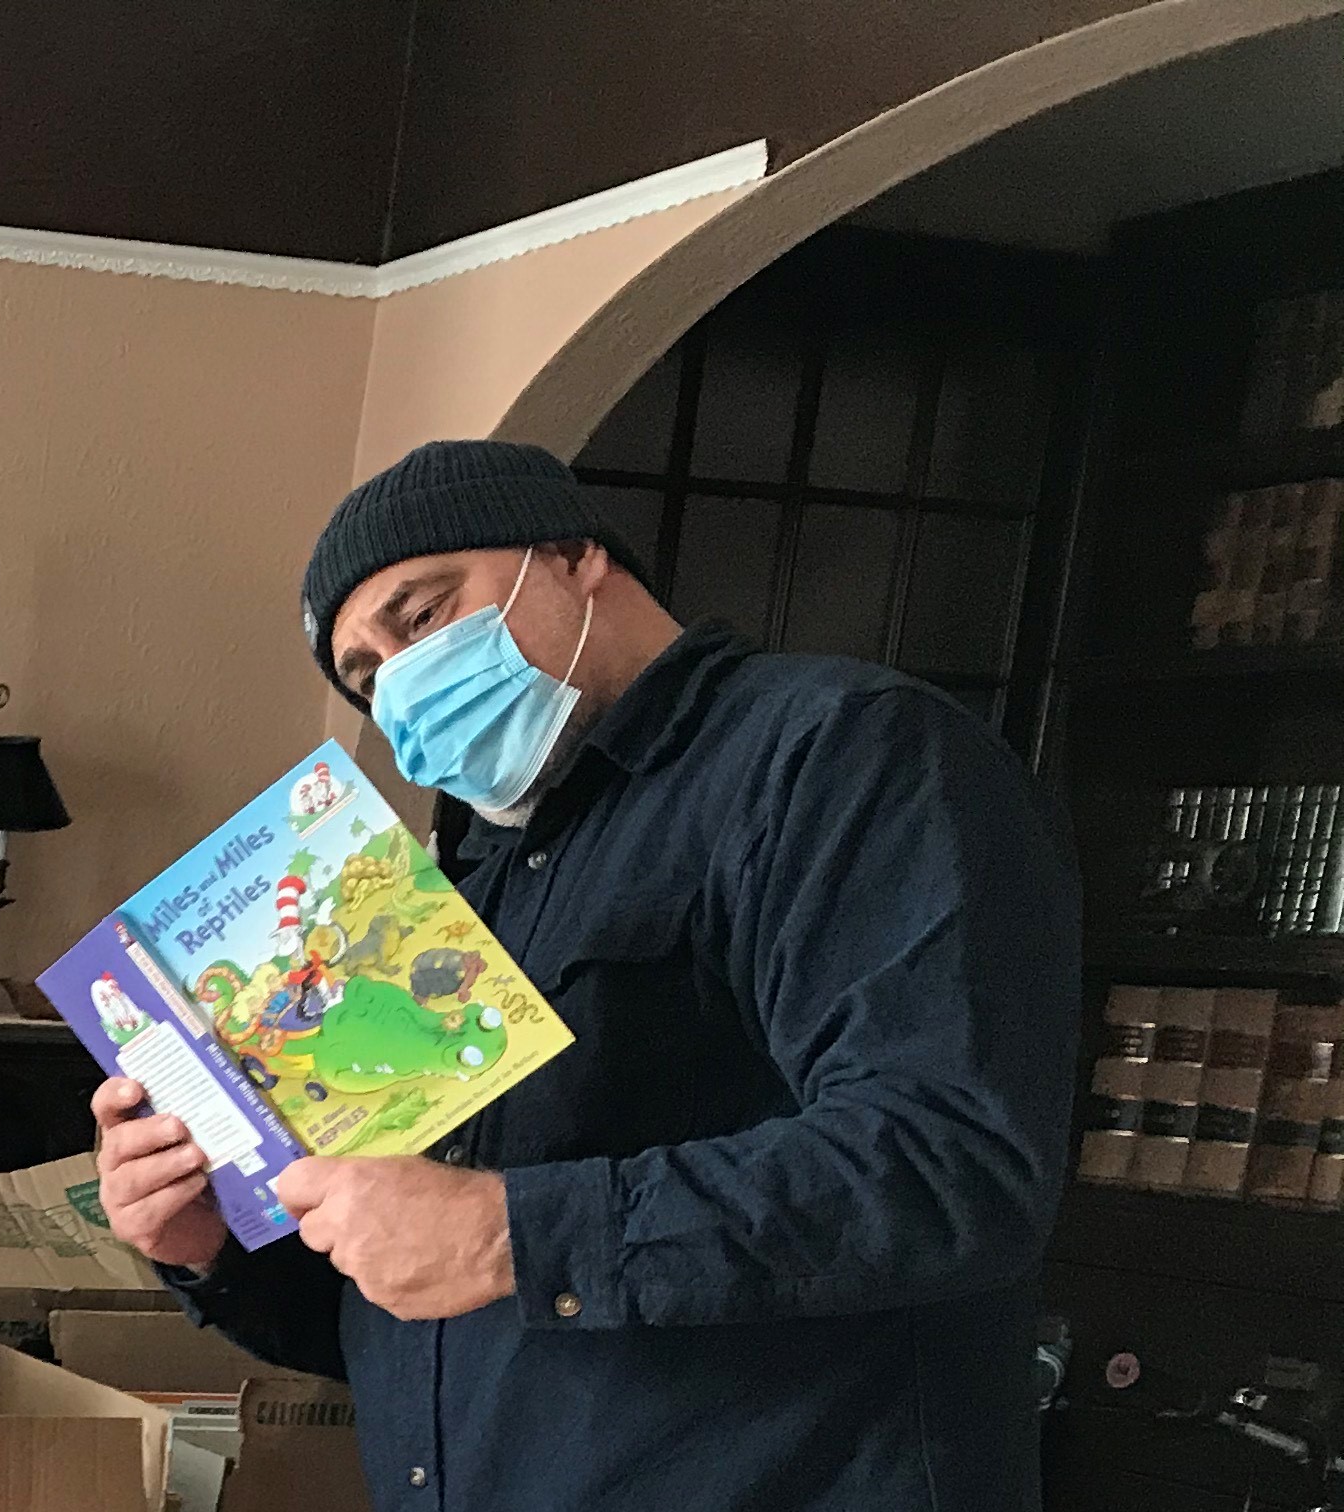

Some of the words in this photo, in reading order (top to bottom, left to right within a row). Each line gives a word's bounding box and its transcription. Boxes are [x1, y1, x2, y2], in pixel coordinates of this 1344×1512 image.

[142, 885, 200, 943] Miles
[214, 824, 275, 879] Miles
[174, 874, 272, 956] Reptiles
